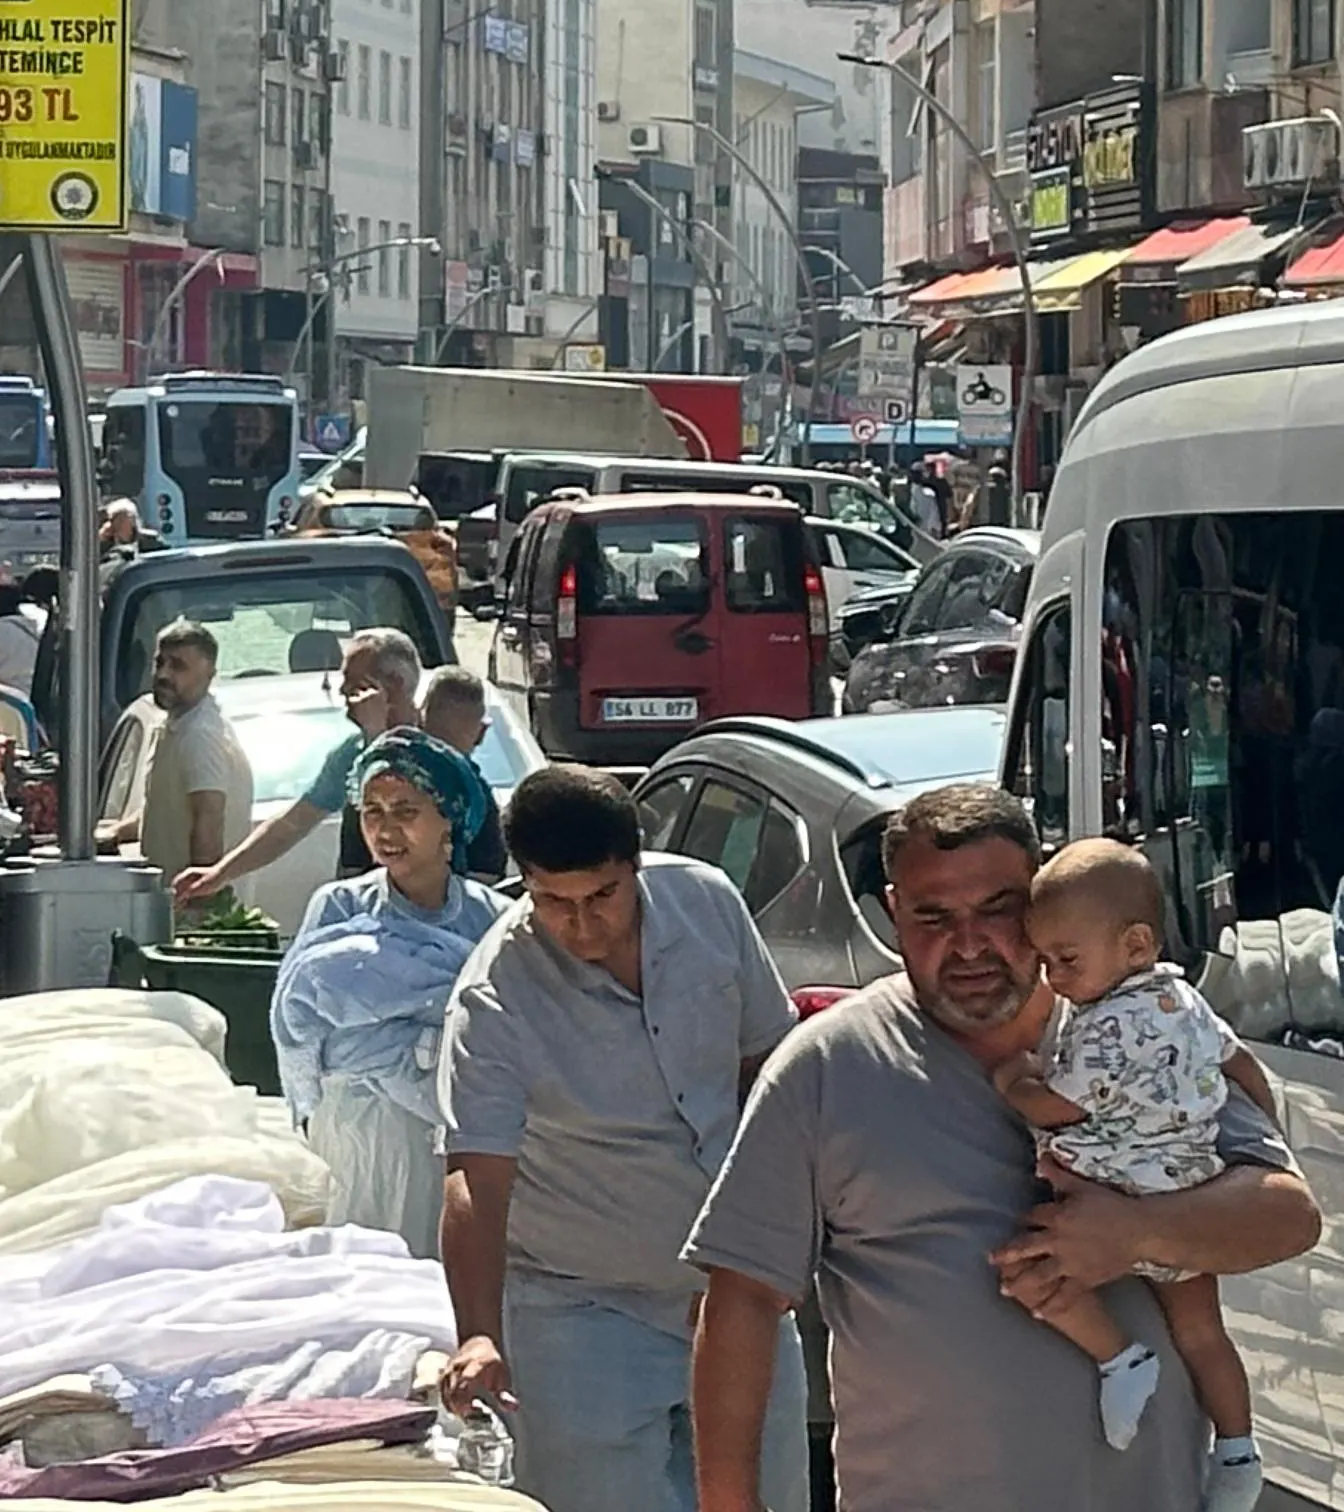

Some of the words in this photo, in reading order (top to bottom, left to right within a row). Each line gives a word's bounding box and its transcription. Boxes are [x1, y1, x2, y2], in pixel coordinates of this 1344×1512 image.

[51, 15, 117, 44] TESPİT
[42, 88, 79, 122] TL
[888, 399, 903, 419] D
